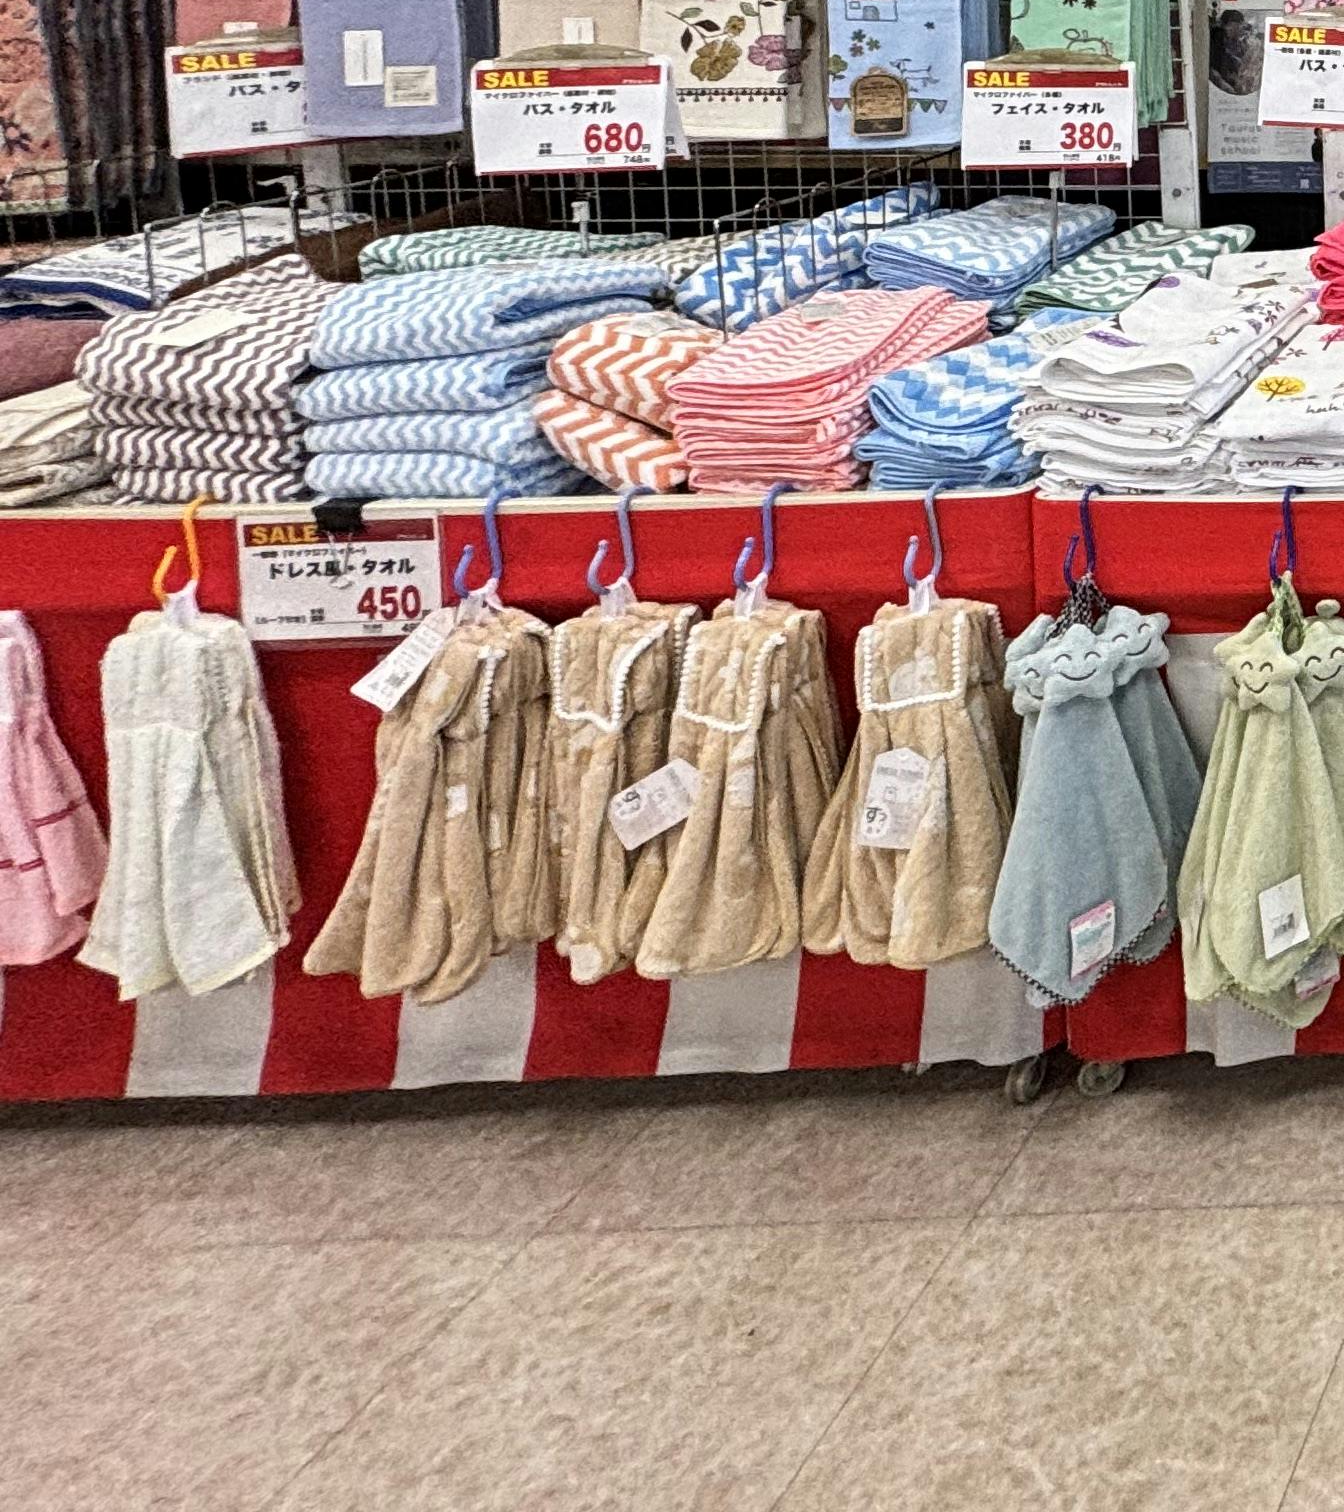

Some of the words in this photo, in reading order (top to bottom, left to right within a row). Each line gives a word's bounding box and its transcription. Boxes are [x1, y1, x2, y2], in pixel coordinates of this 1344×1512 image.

[1275, 27, 1327, 44] SALE
[181, 52, 257, 72] SALE
[483, 71, 549, 88] SALE
[973, 72, 1030, 86] SALE
[228, 81, 306, 97] バス・タ
[523, 101, 616, 115] バス・タオル
[991, 102, 1105, 115] フェイス・タオル
[251, 525, 319, 545] SALE
